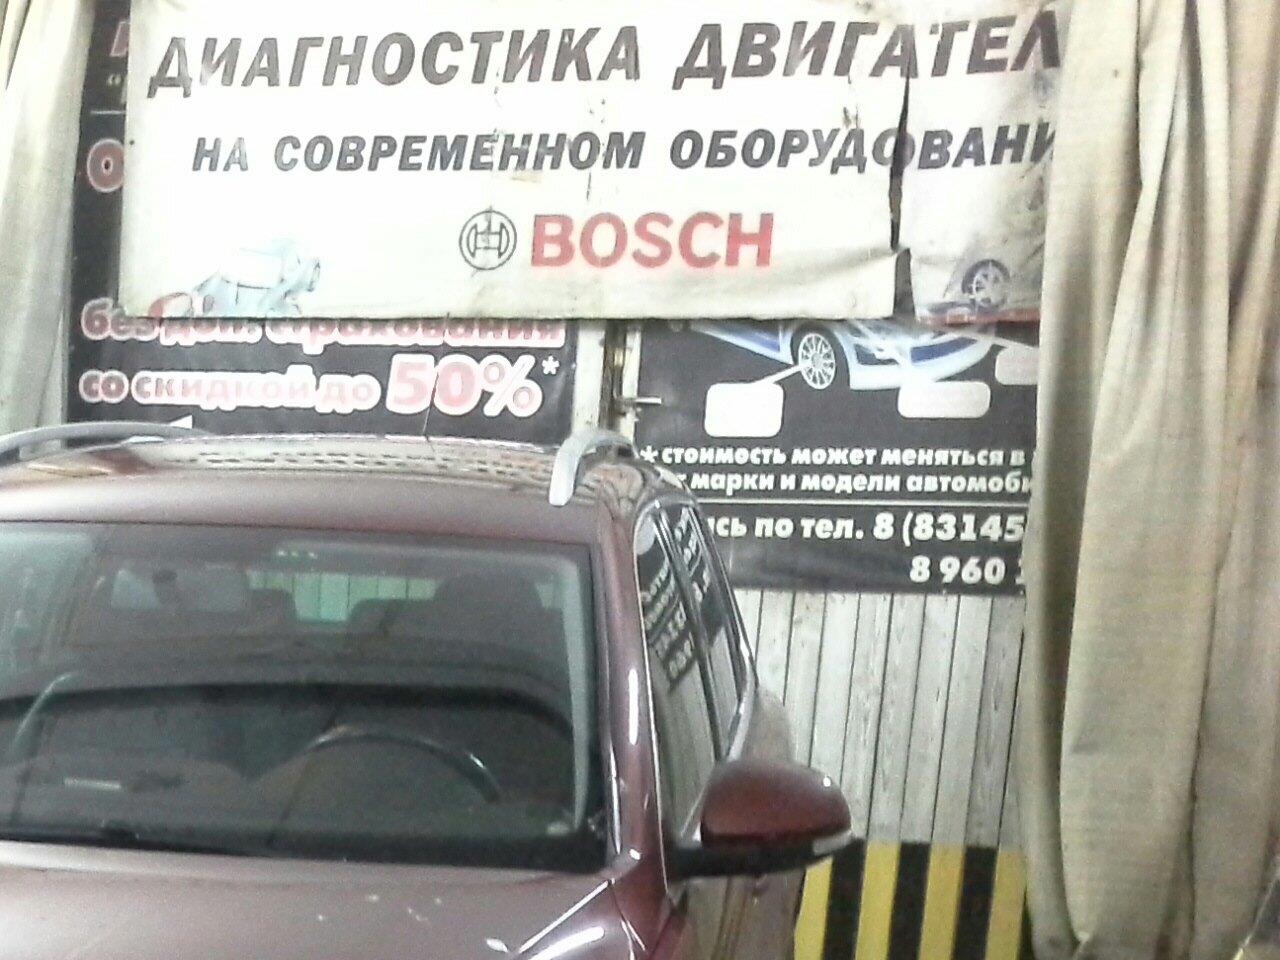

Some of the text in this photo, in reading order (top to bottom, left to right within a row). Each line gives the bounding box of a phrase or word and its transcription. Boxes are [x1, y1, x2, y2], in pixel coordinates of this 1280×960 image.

[148, 26, 641, 98] ДИАГНОСТИКА
[192, 137, 249, 171] НА
[273, 131, 646, 171] СОВРЕМЕННОМ
[530, 212, 774, 269] BOSCH
[79, 369, 129, 403] со
[318, 373, 382, 414] до
[662, 447, 787, 465] стоимость
[791, 448, 877, 466] может
[881, 448, 1004, 466] меняться
[690, 473, 775, 496] марки
[780, 474, 796, 490] и
[800, 473, 901, 494] модели
[754, 518, 794, 538] по
[800, 518, 865, 540] тел.
[873, 511, 895, 540] 8
[910, 555, 931, 583] 8
[939, 556, 1006, 584] 960
